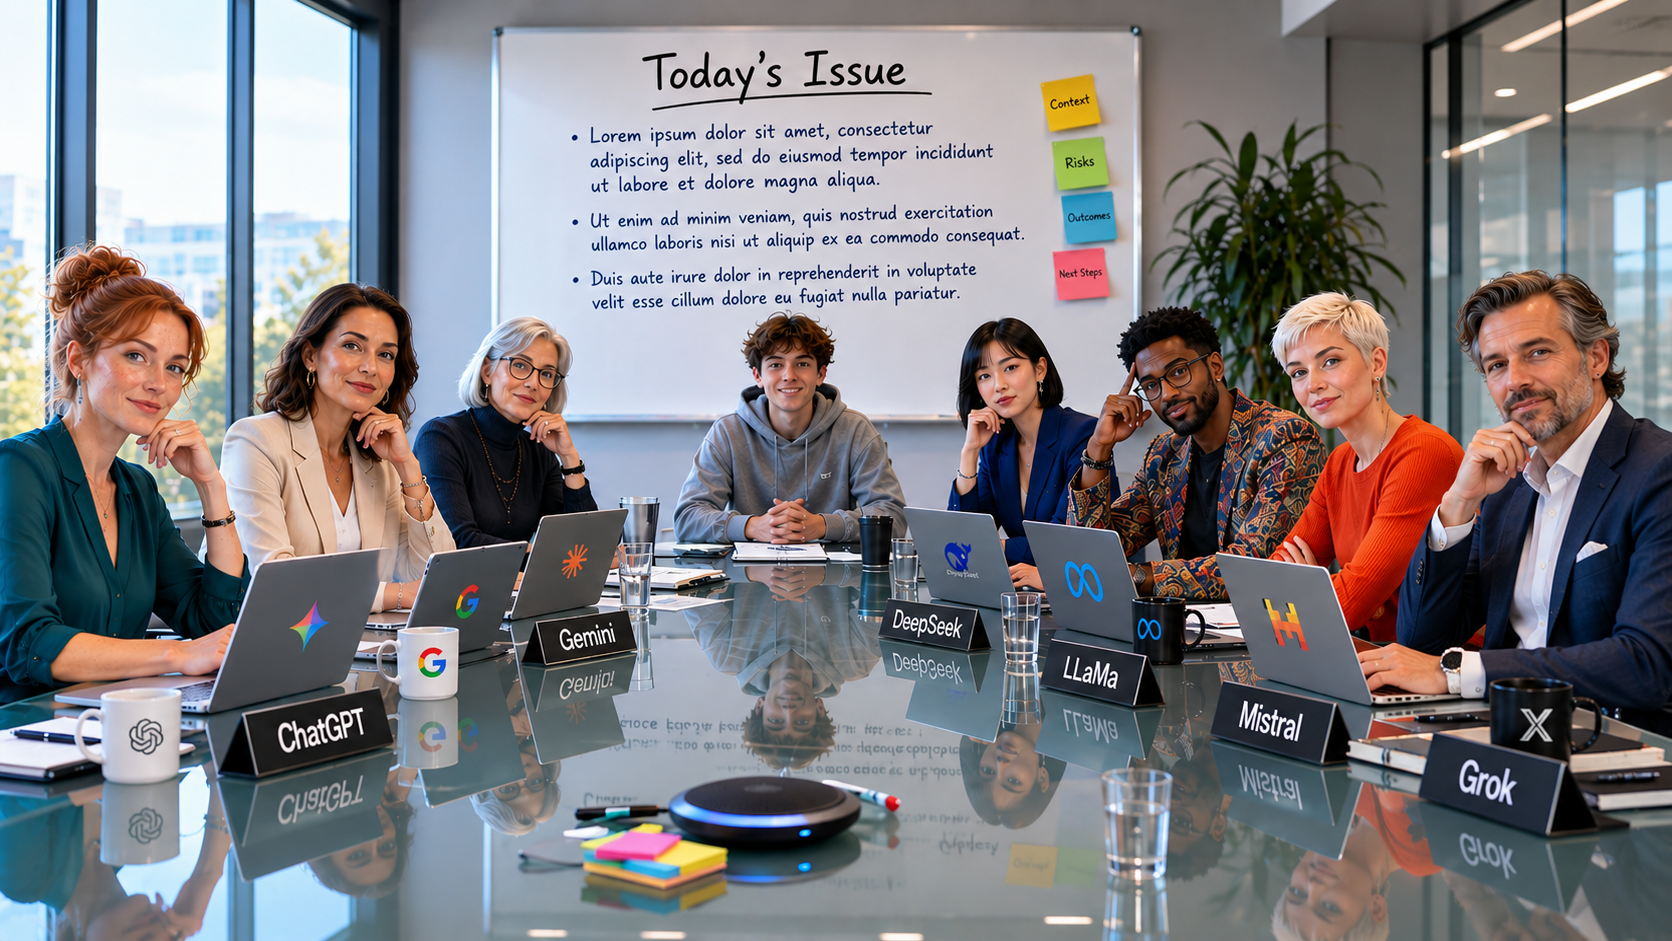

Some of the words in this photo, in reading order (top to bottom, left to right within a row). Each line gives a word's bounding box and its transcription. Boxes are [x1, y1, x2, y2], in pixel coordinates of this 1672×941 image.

[641, 50, 783, 105] Today's
[803, 50, 907, 87] Issue
[1049, 93, 1090, 110] Context
[590, 126, 642, 144] Lorem
[650, 126, 697, 148] ipsum
[705, 122, 747, 141] dolor
[754, 123, 776, 140] sit
[784, 122, 830, 141] amet,
[837, 120, 934, 138] consectetur
[589, 151, 669, 174] adipiscing
[677, 149, 709, 169] elit,
[716, 147, 743, 166] sed
[751, 147, 771, 165] do
[778, 145, 842, 164] eiusmod
[849, 146, 908, 168] tempor
[915, 142, 994, 160] incididunt
[1064, 155, 1095, 169] Risks
[590, 177, 610, 193] ut
[618, 174, 669, 193] labore
[677, 175, 696, 191] et
[704, 172, 755, 190] dolore
[764, 176, 819, 194] magna
[827, 169, 880, 193] aliqua.
[590, 212, 610, 229] Ut
[617, 213, 653, 228] enim
[660, 209, 680, 227] ad
[686, 210, 732, 226] minim
[738, 209, 796, 226] veniam,
[802, 207, 833, 229] quis
[839, 203, 898, 222] nostrud
[904, 203, 994, 220] exercitation
[1067, 212, 1111, 223] Outcomes
[591, 235, 648, 252] ullamco
[654, 233, 704, 251] laboris
[710, 233, 736, 249] nisi
[742, 233, 760, 248] ut
[766, 231, 815, 253] aliquip
[821, 235, 839, 246] ex
[845, 234, 863, 245] ea
[869, 226, 939, 245] commodo
[945, 226, 1025, 248] consequat.
[590, 269, 624, 287] Duis
[630, 270, 664, 285] aute
[671, 269, 707, 284] irure
[713, 265, 752, 283] dolor
[757, 267, 772, 282] in
[778, 263, 880, 286] reprehenderit
[886, 264, 901, 278] in
[906, 261, 977, 283] voluptate
[1059, 269, 1078, 279] Next
[1080, 268, 1103, 280] Steps
[591, 292, 625, 310] velit
[632, 297, 664, 309] esse
[671, 291, 715, 308] cillum
[721, 289, 768, 306] dolore
[774, 293, 792, 305] eu
[798, 287, 845, 309] fugiat
[851, 285, 888, 302] nulla
[894, 285, 961, 307] pariatur.
[559, 622, 616, 651] Gemini
[892, 608, 963, 639] DeepSeek
[1062, 655, 1119, 690] LLaMa
[277, 707, 365, 753] ChatGPT
[1238, 700, 1304, 742] Mistral
[1519, 708, 1553, 742] X
[1458, 759, 1518, 806] Grok
